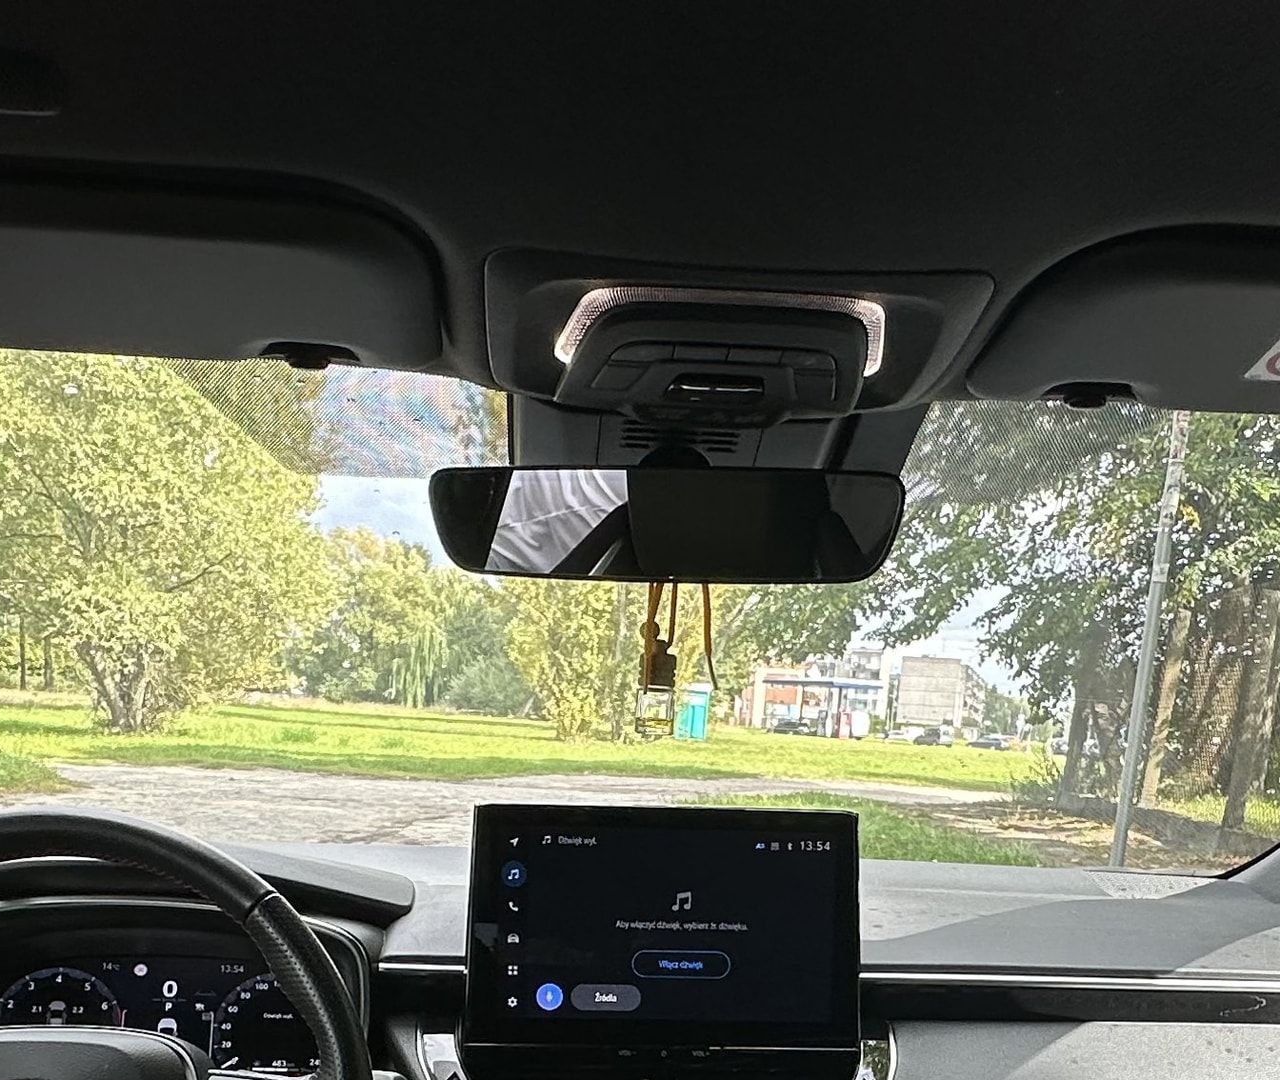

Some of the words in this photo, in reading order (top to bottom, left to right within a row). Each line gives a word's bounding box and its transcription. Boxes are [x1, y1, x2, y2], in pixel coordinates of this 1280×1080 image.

[55, 974, 62, 983] 4
[28, 981, 35, 991] 3
[84, 982, 91, 991] 5
[162, 980, 178, 998] 0
[255, 982, 269, 991] 100
[240, 991, 251, 1000] 80
[7, 999, 15, 1009] 2
[101, 1001, 109, 1011] 6
[165, 1001, 173, 1012] P
[221, 1022, 232, 1031] 40
[221, 1041, 232, 1049] 20
